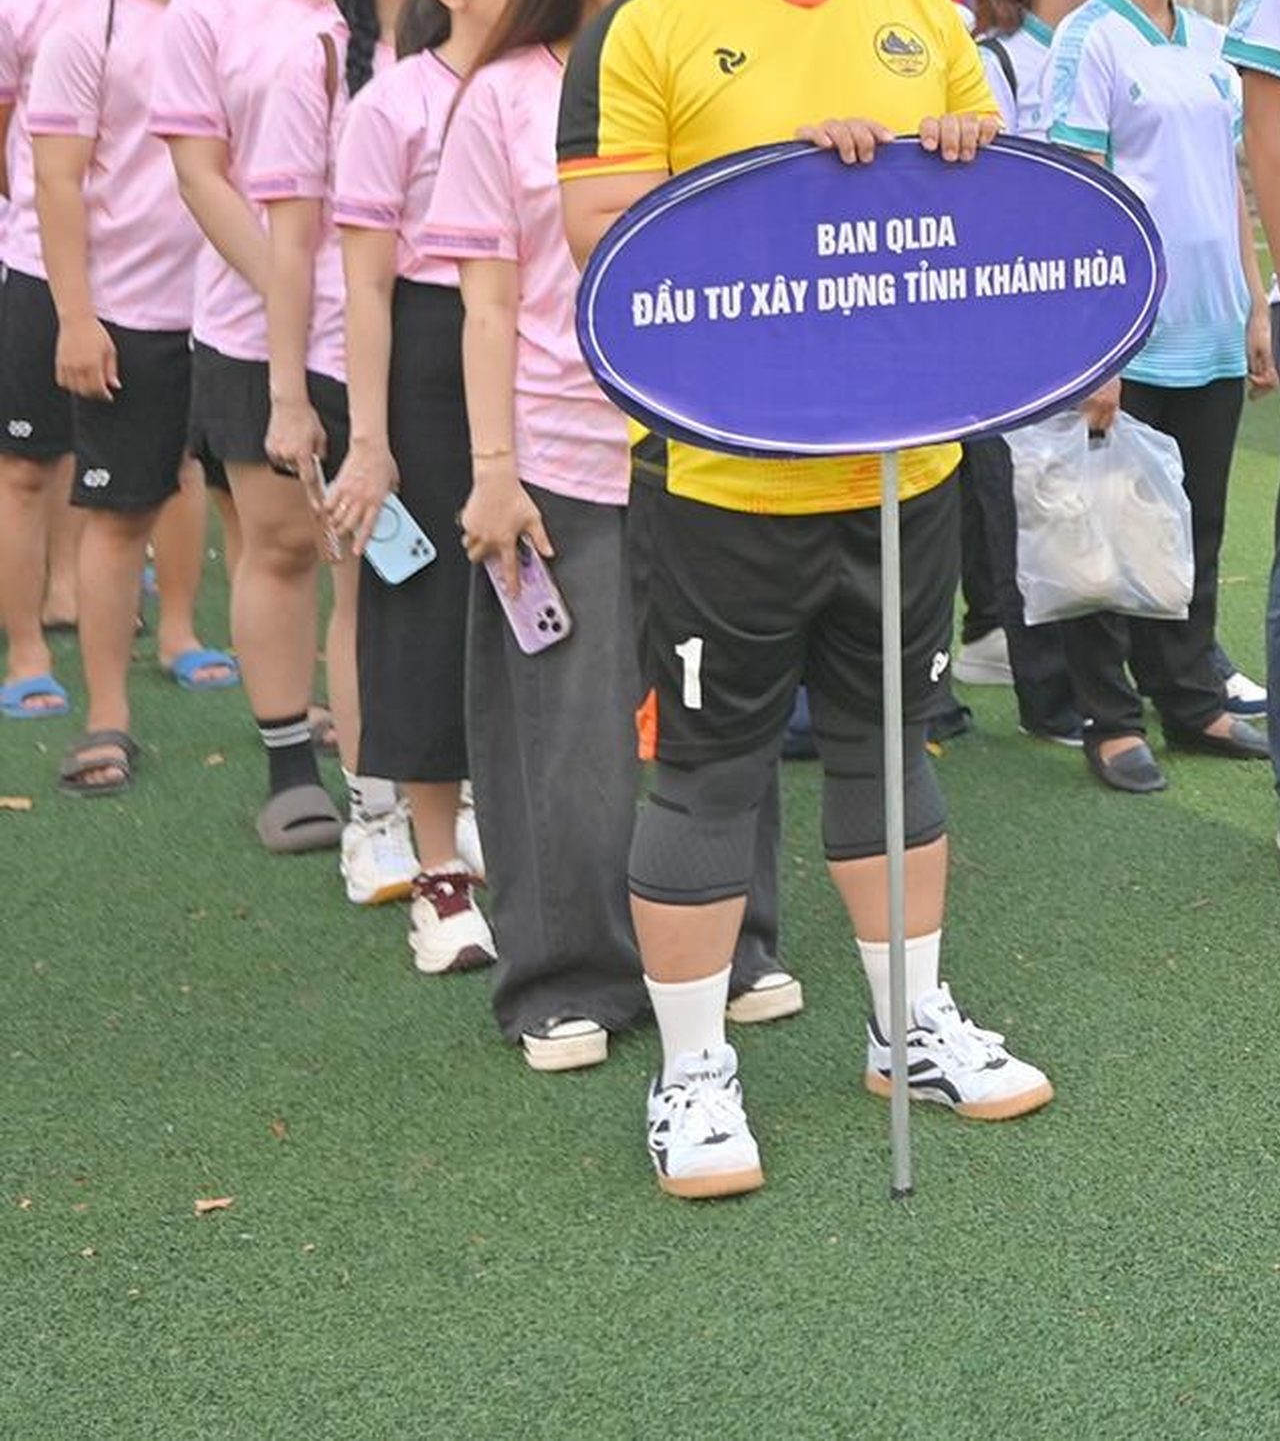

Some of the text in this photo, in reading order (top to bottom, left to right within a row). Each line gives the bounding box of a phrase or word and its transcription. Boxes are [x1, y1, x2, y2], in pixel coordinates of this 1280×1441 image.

[817, 215, 957, 256] BAN QLDA
[631, 250, 1127, 326] ĐẦU TƯ XÂY DỰNG TỈNH KHÁNH HÒA
[675, 636, 703, 709] 1
